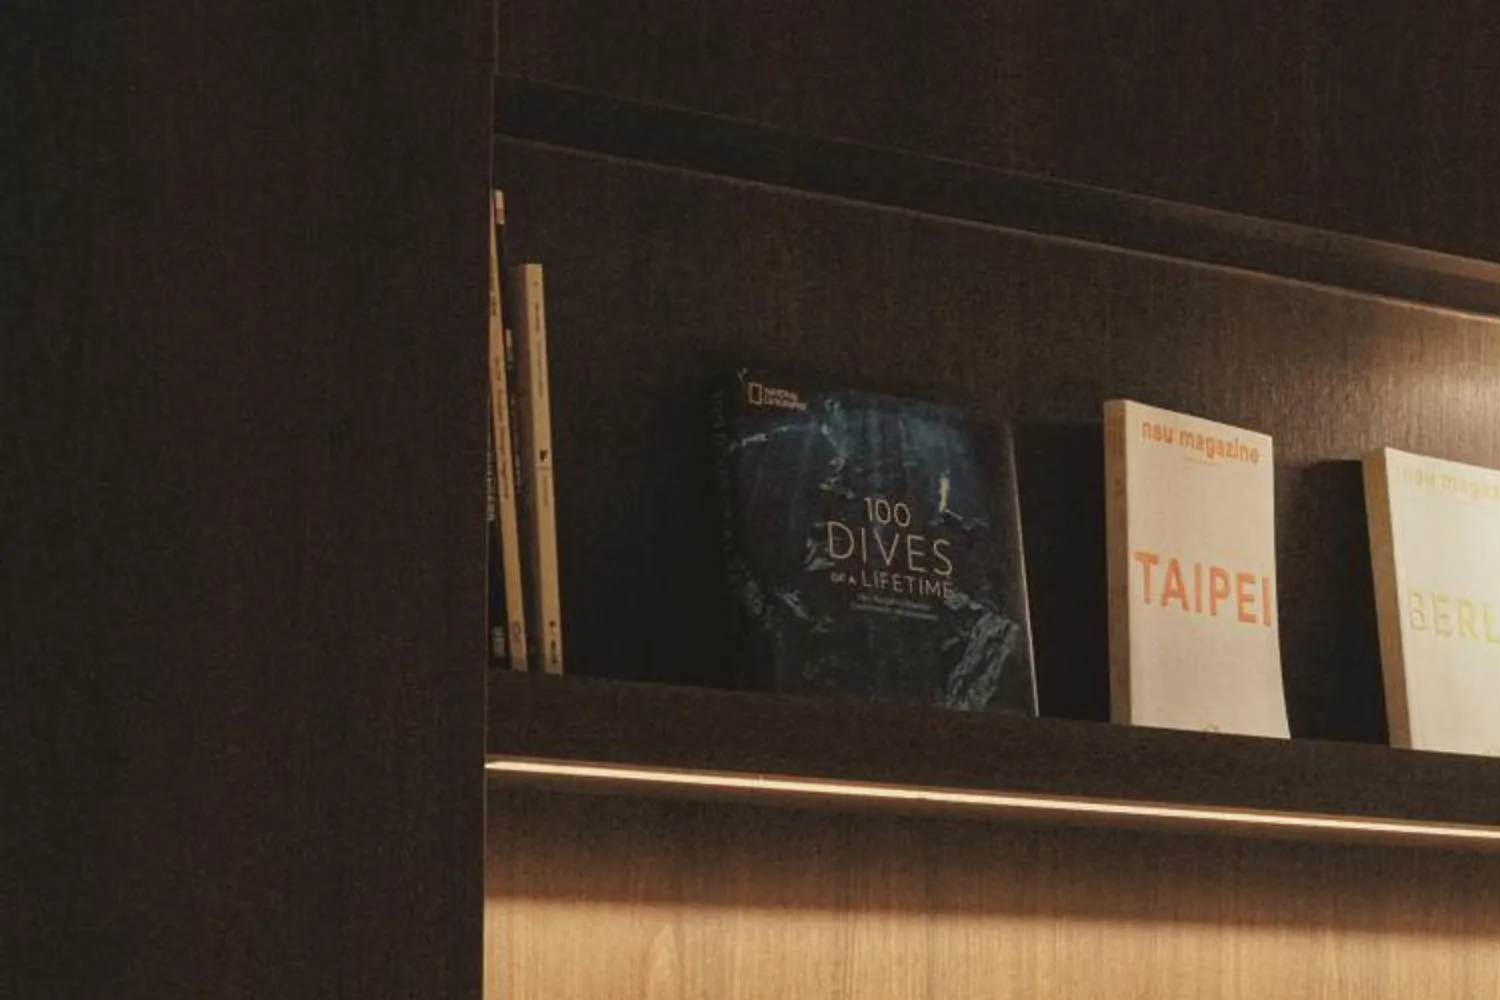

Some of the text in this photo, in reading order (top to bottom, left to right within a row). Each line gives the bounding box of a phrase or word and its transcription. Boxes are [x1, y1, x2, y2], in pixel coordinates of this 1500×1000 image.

[1142, 420, 1260, 465] nau magazine
[864, 496, 911, 528] 100
[827, 521, 953, 576] DIVES
[861, 568, 955, 599] LIFETIME
[1134, 551, 1272, 627] TAIPEI
